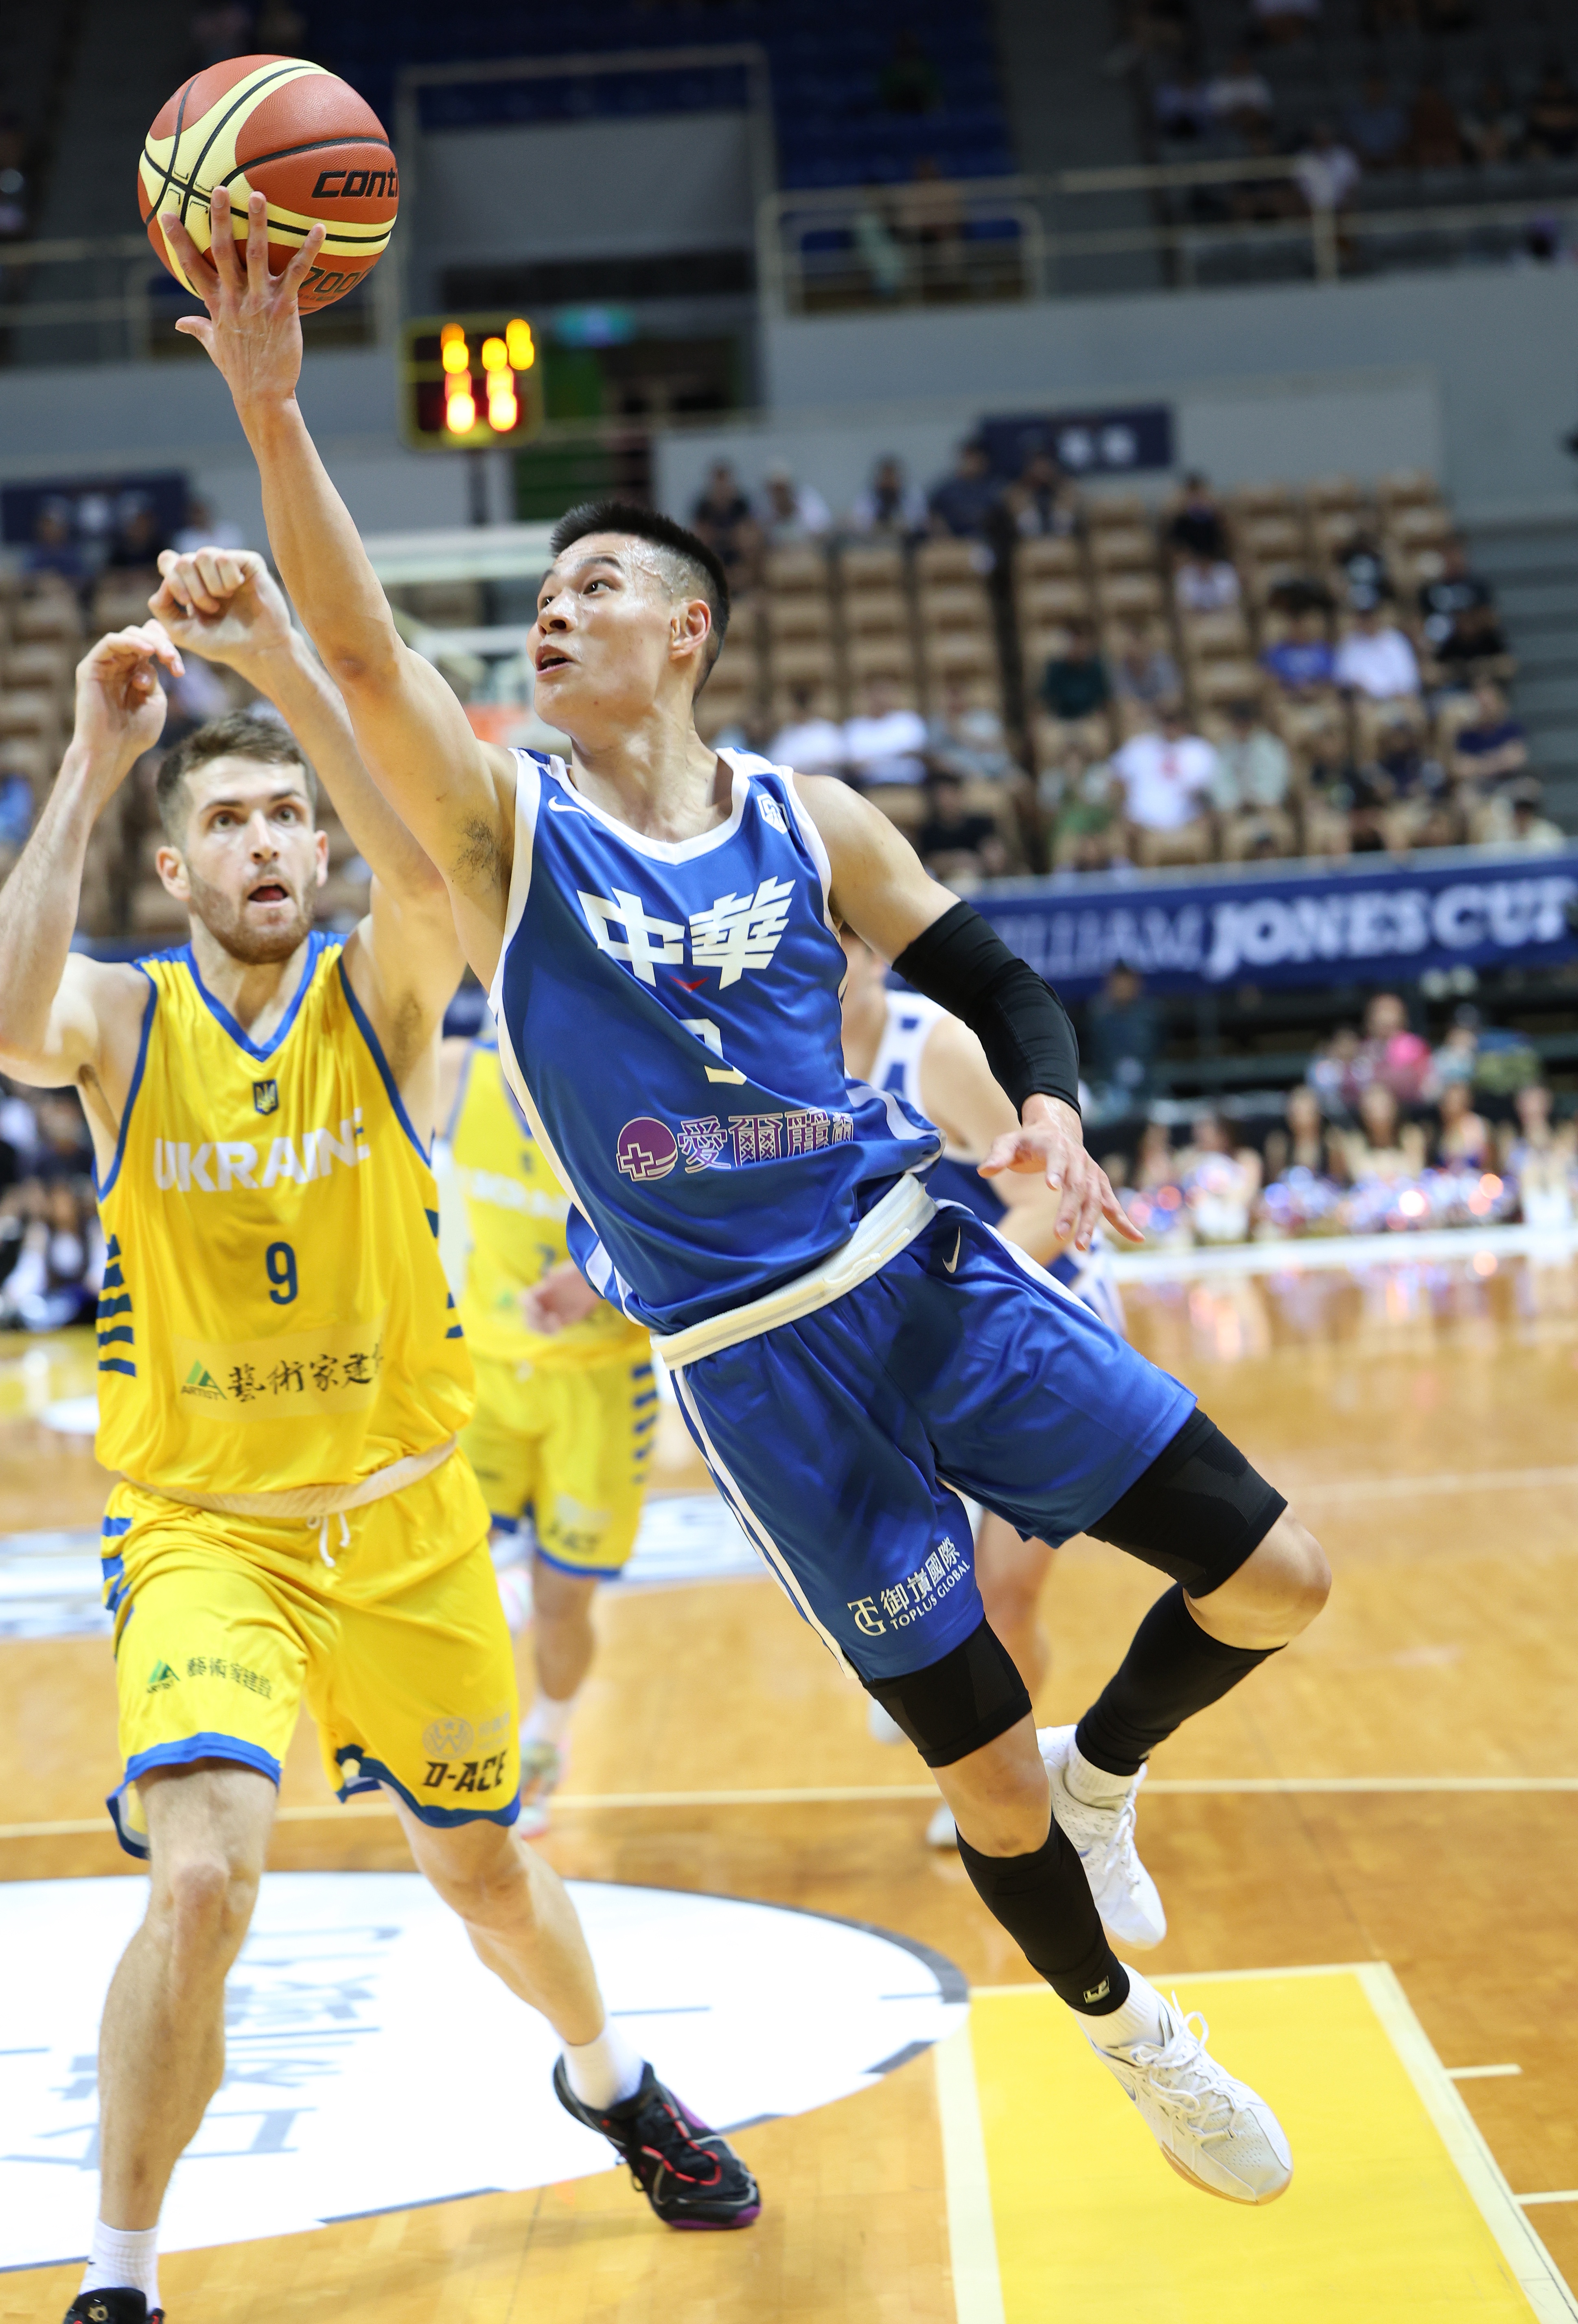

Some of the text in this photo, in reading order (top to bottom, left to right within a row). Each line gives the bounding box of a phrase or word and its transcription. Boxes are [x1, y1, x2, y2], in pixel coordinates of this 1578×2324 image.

[577, 875, 796, 990] 中華
[1206, 891, 1429, 980] JONES
[265, 1242, 298, 1305] 9
[890, 1559, 970, 1630] TOPLUS GLOBAL
